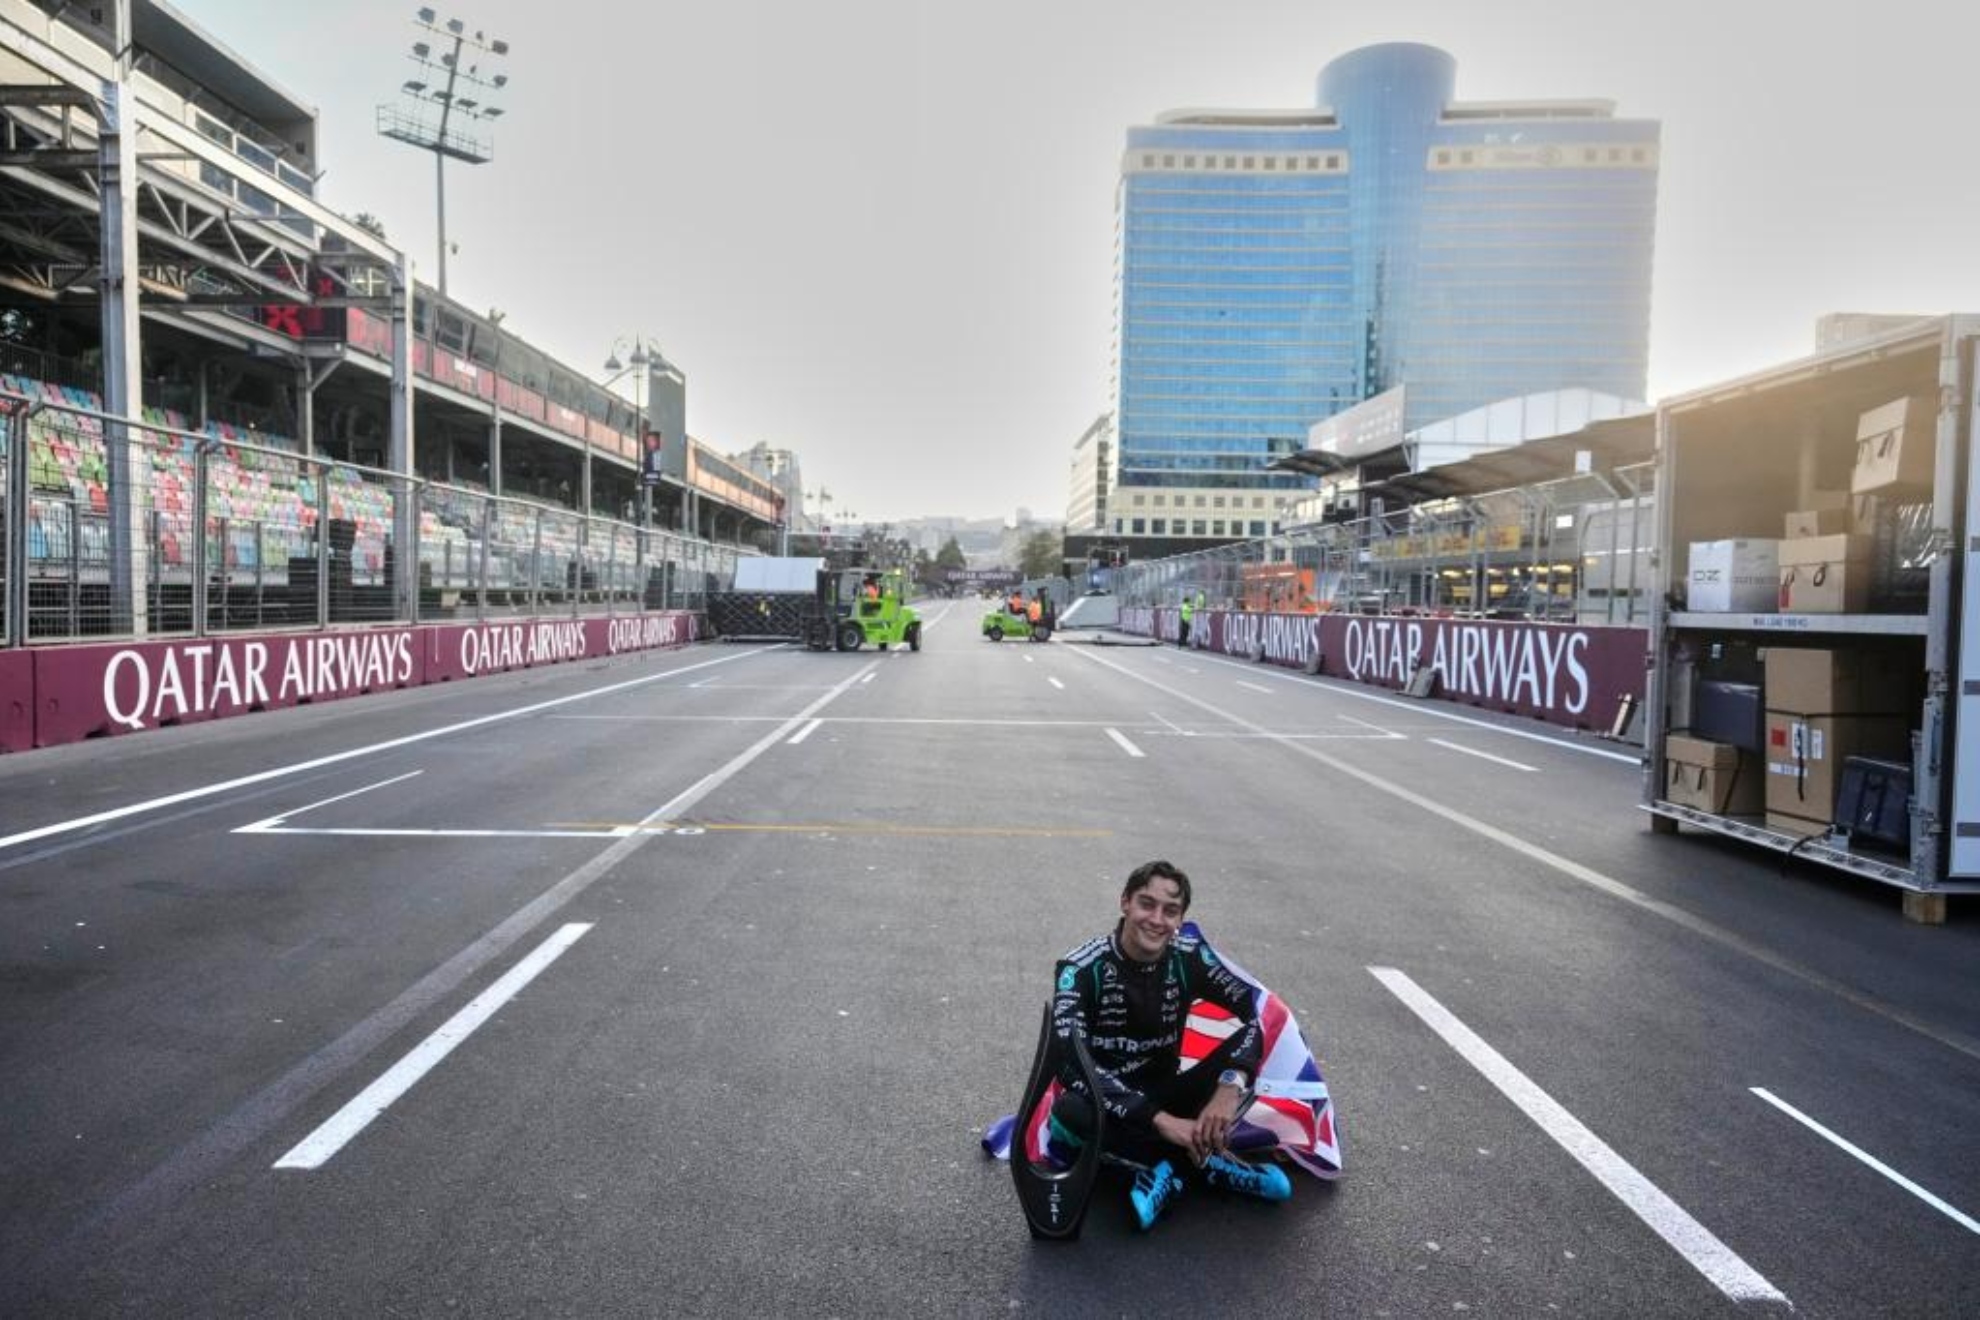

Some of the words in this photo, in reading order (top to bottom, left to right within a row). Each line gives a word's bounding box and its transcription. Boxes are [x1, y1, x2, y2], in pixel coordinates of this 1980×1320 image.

[461, 626, 523, 673] QATAR
[526, 622, 586, 662] AIRWAYS
[608, 619, 640, 653] QATAR
[641, 616, 676, 646] AIRWAYS
[1223, 614, 1258, 653] QATAR
[1261, 614, 1319, 662] AIRWAYS
[104, 643, 269, 729] QATAR
[280, 632, 412, 699] AIRWAYS
[1345, 620, 1422, 683] QATAR
[1431, 623, 1588, 714] AIRWAYS
[1092, 1034, 1177, 1053] PETRONA
